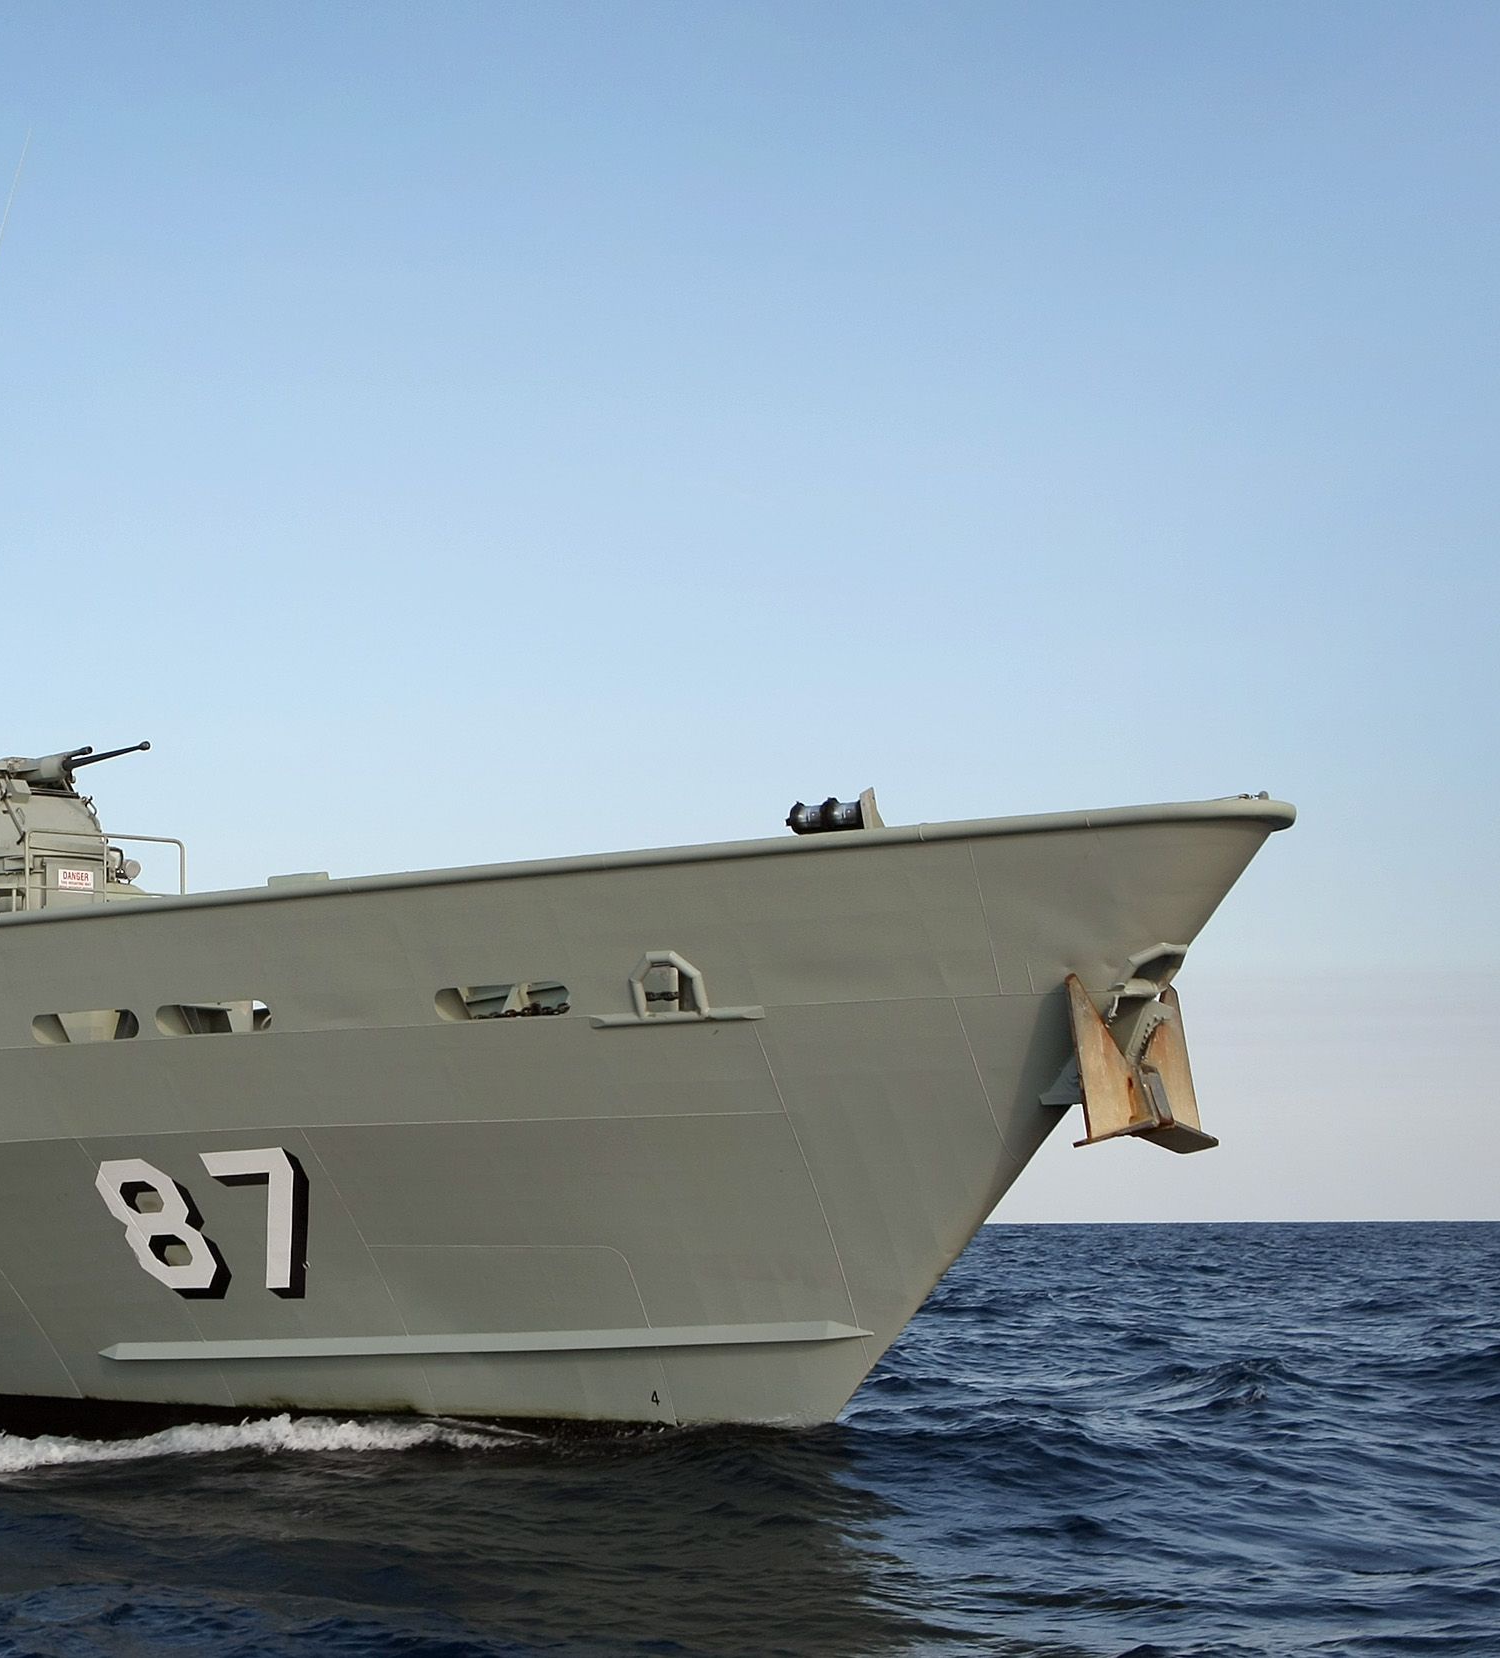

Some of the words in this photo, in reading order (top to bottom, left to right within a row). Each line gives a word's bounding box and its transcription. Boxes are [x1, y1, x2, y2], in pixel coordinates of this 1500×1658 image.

[62, 871, 89, 881] DANGER
[95, 1147, 309, 1299] 87
[651, 1390, 660, 1406] 4
